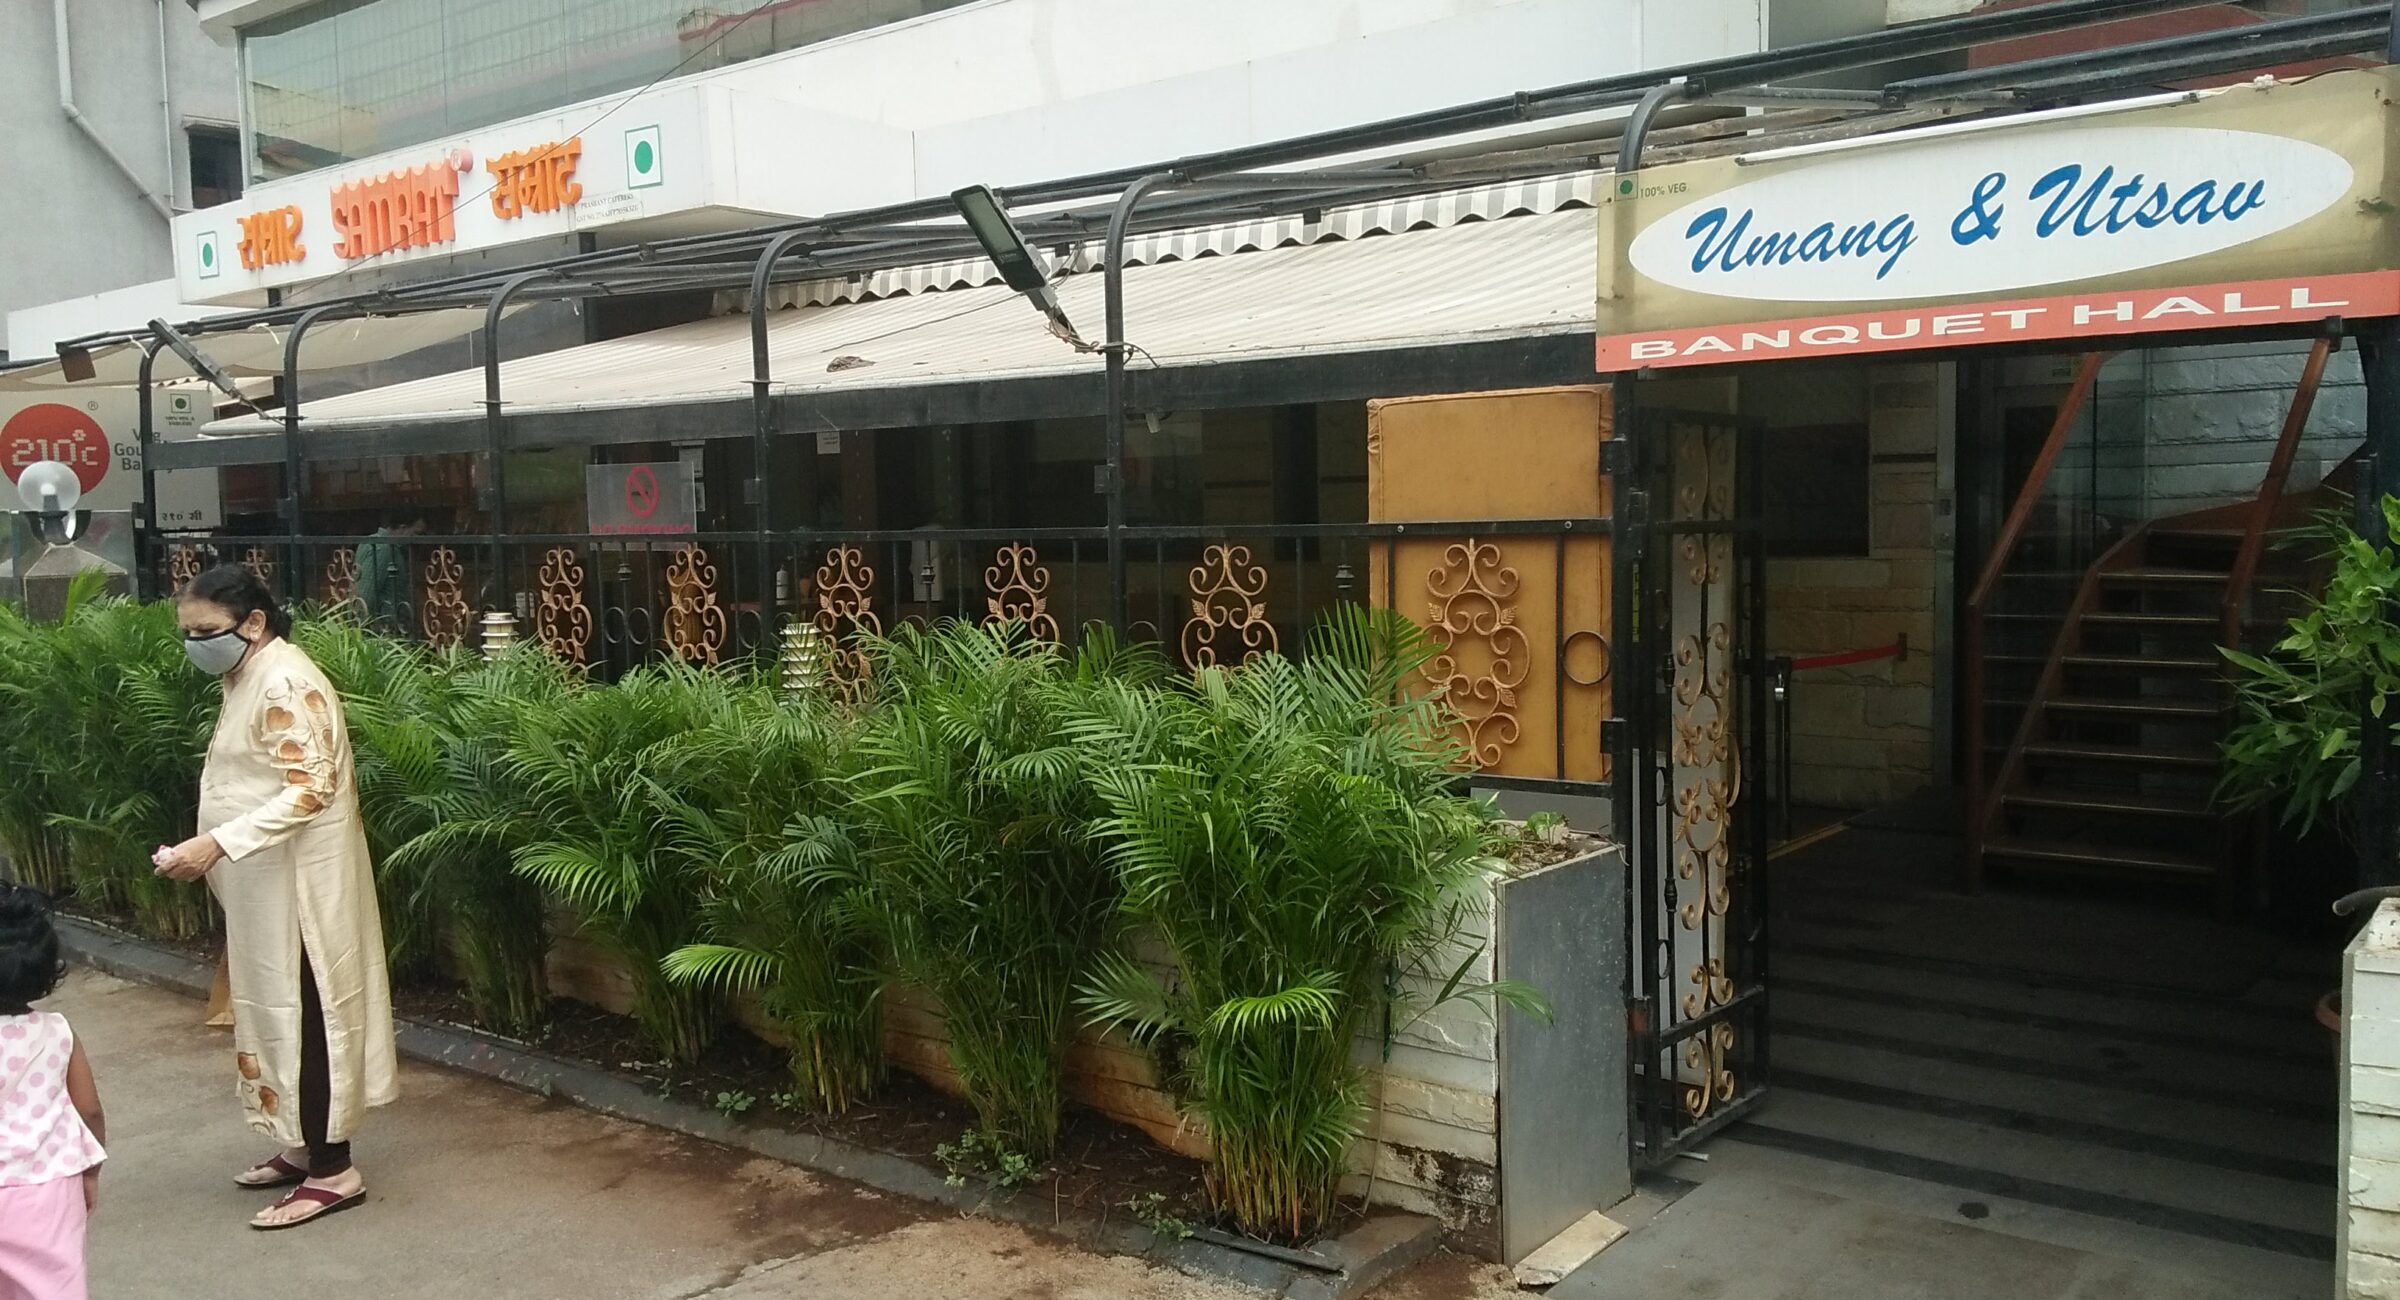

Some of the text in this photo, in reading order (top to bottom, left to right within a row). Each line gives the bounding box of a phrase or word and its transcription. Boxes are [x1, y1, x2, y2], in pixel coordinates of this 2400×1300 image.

[330, 158, 460, 259] SAMRAT
[486, 136, 583, 220] सम्राट
[1640, 184, 1665, 198] 100%
[1685, 164, 2265, 280] Umang & Utsav
[1630, 288, 2349, 360] BANQUET HALL
